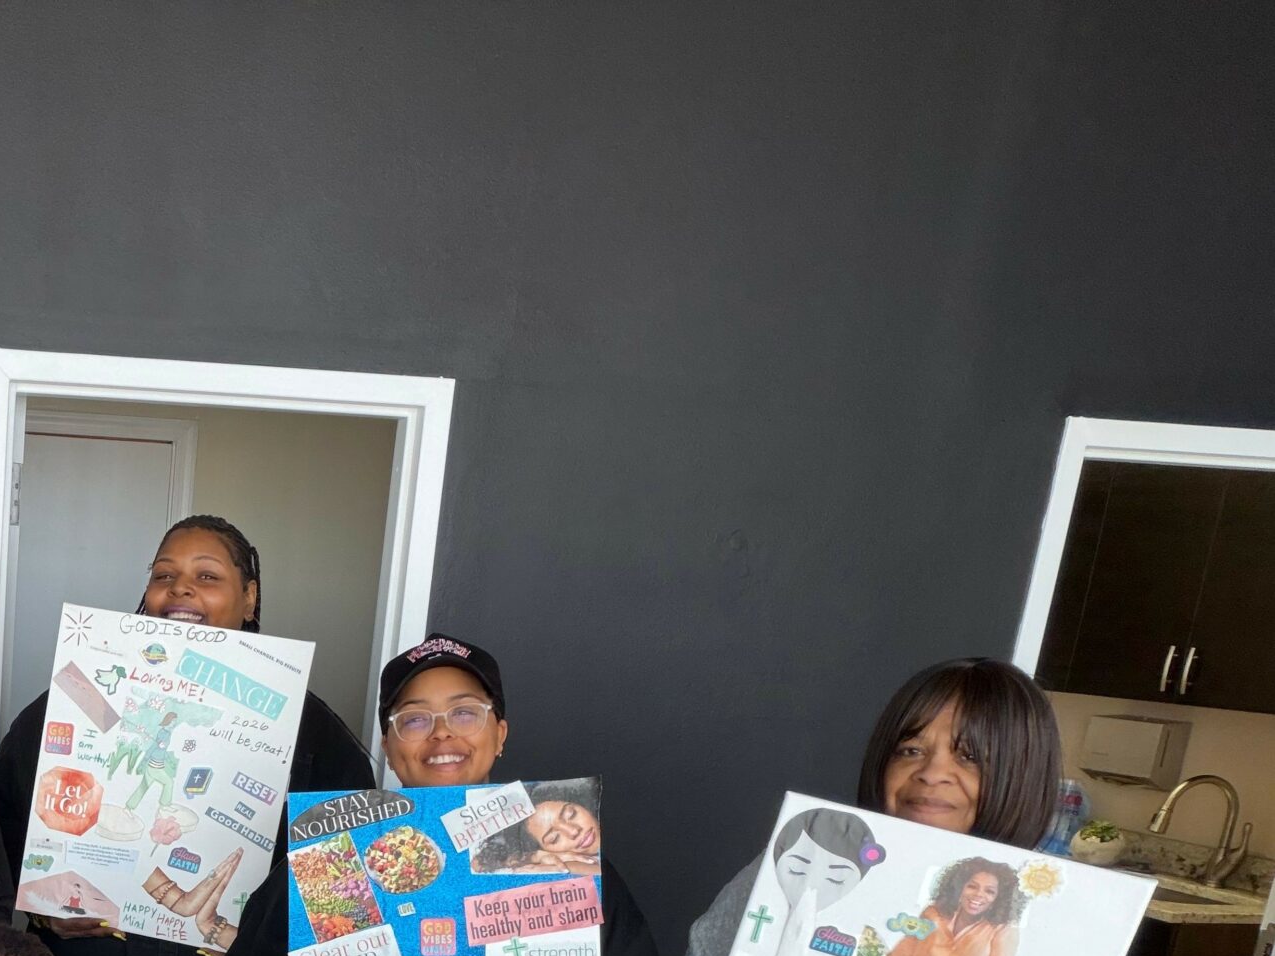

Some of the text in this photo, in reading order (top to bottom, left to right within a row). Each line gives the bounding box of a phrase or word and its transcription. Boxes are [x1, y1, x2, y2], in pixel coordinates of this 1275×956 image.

[129, 666, 205, 703] Loving ME!
[178, 654, 286, 717] CHANGE
[230, 715, 270, 732] 2026
[47, 735, 71, 746] VIBES
[209, 727, 233, 746] will
[53, 780, 82, 799] Let
[235, 774, 277, 802] RESET
[44, 794, 88, 818] It Go!
[236, 803, 254, 817] REAL
[324, 790, 374, 817] STAY
[459, 792, 509, 826] Sleep
[292, 799, 412, 841] NOURISHED
[453, 802, 533, 850] BETTER.
[210, 810, 274, 850] Good Habits
[169, 857, 200, 873] FAITH
[123, 902, 157, 919] HAPPY
[474, 887, 587, 920] Keep your brain
[156, 913, 186, 930] HAPPY
[423, 921, 452, 936] GOD
[470, 906, 599, 940] healthy and sharp
[356, 931, 390, 951] out
[422, 935, 453, 945] VIBES
[817, 928, 855, 946] Have
[811, 938, 853, 956] FAITH
